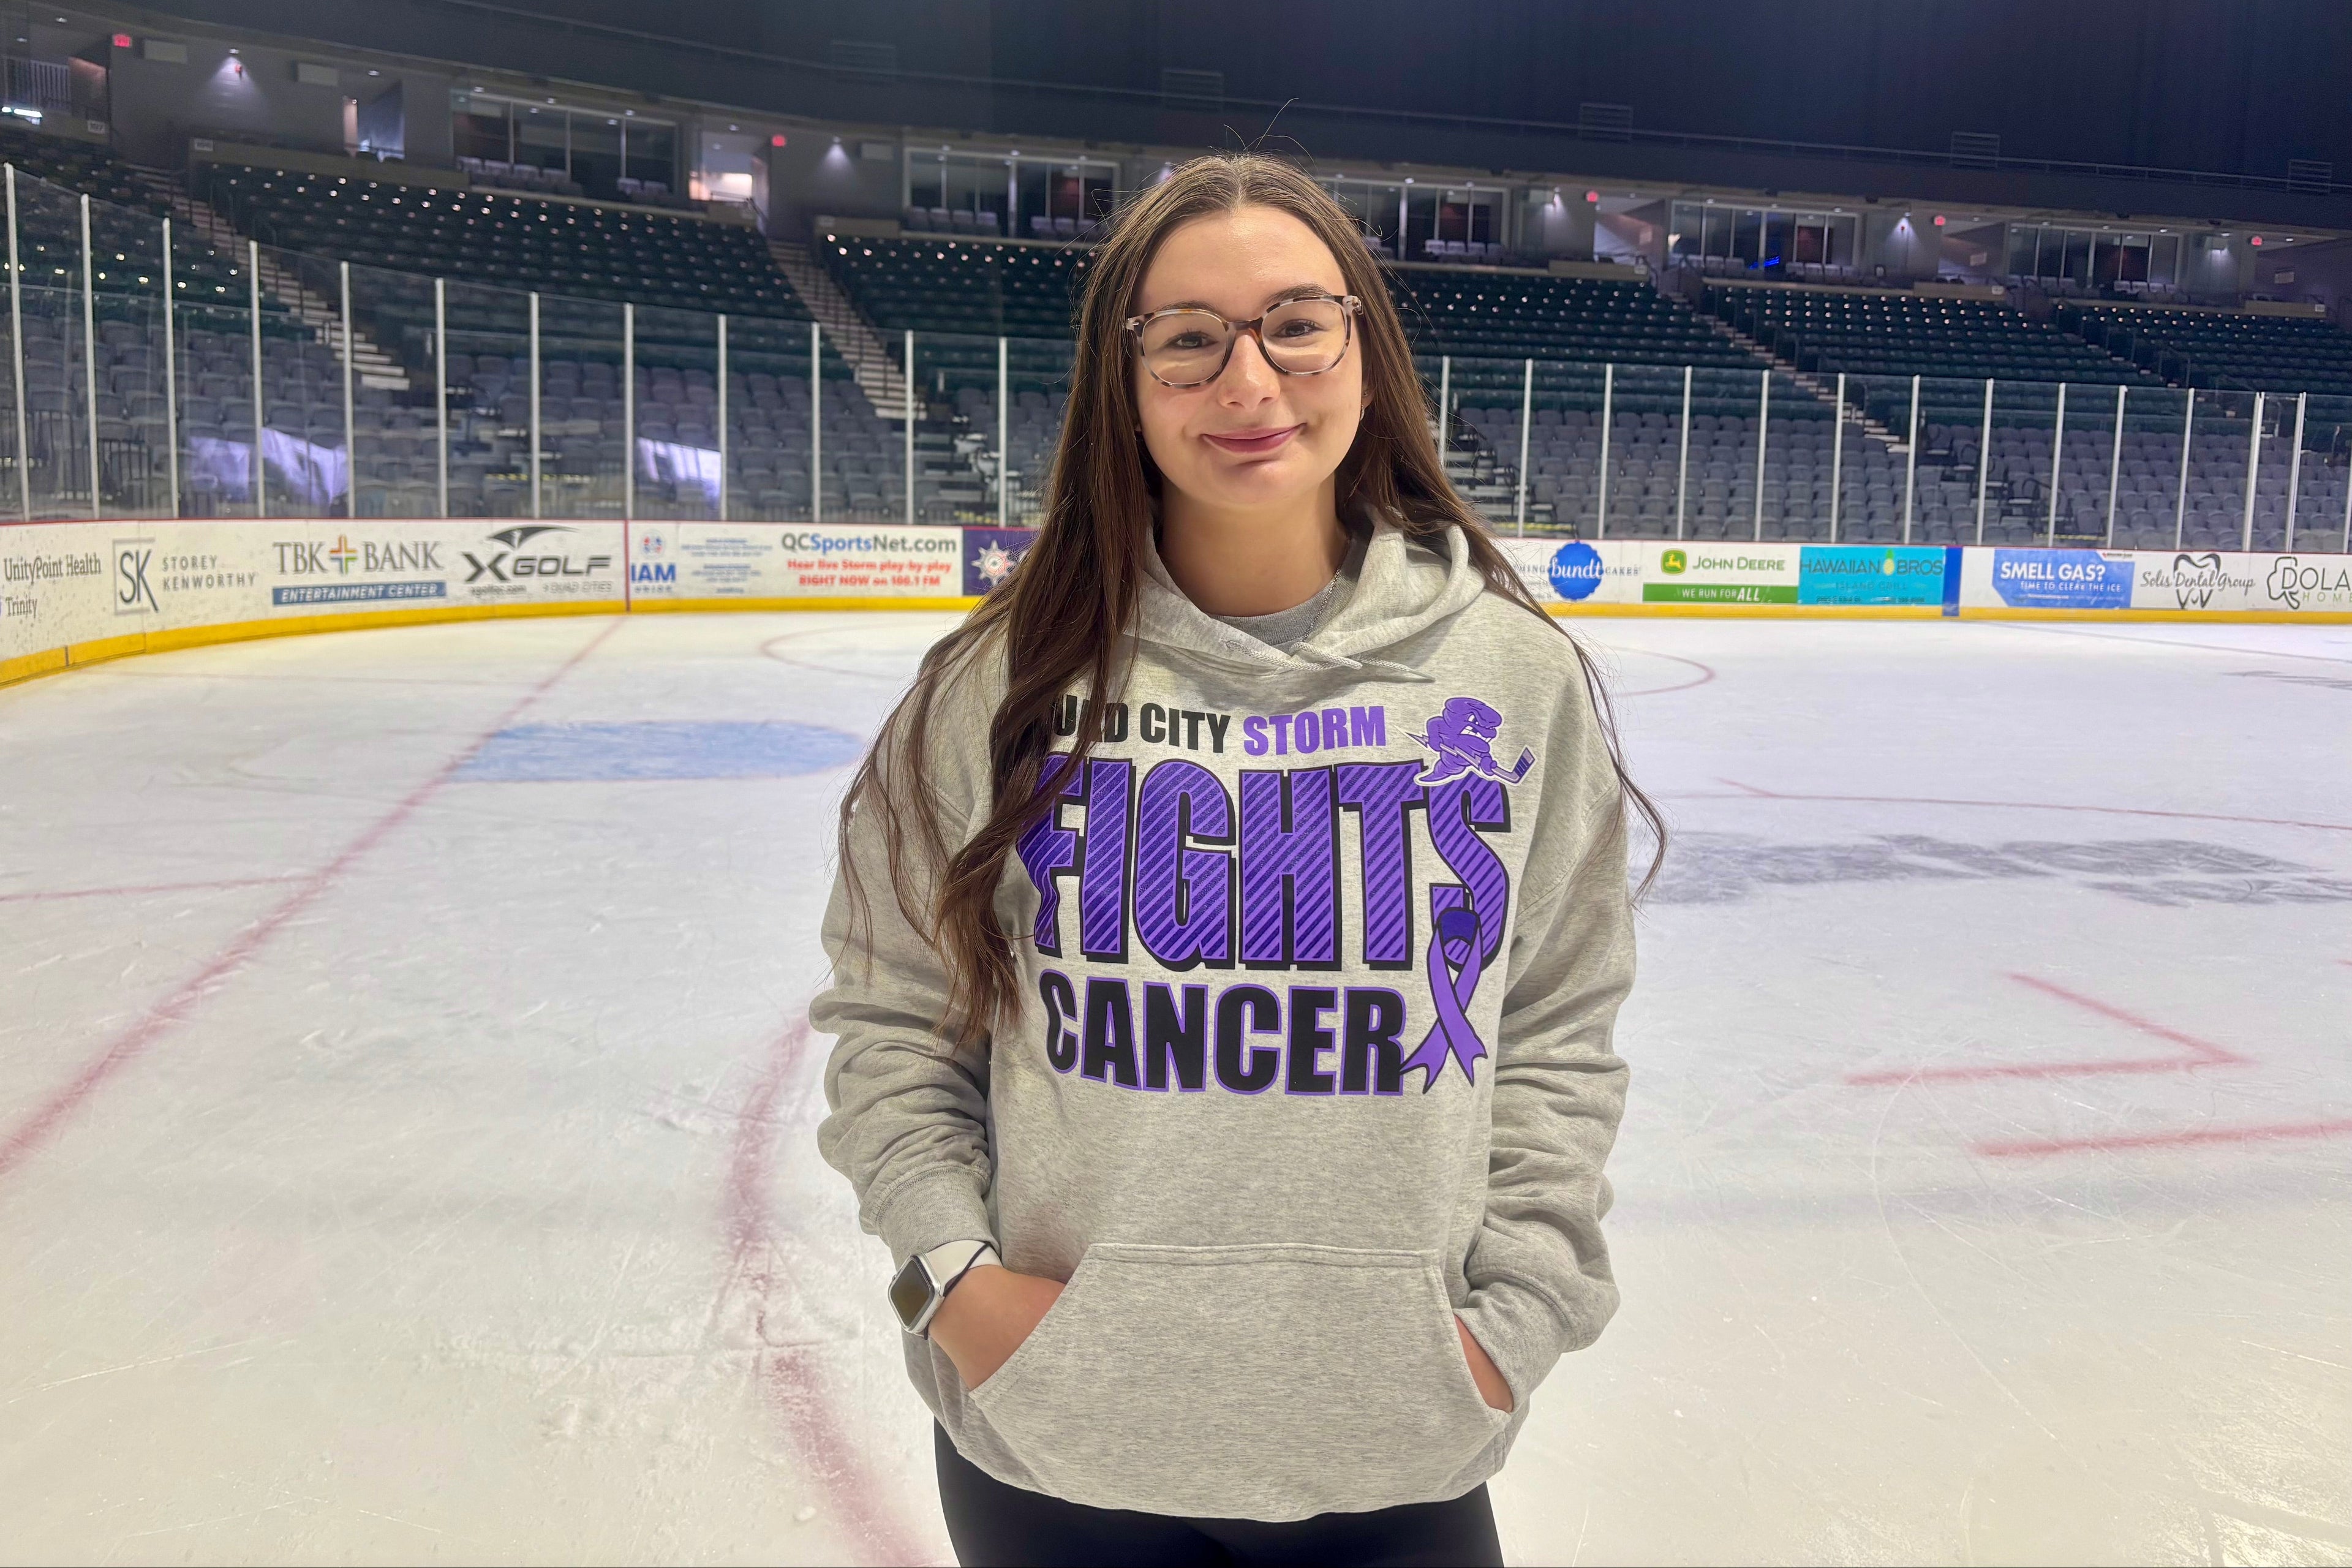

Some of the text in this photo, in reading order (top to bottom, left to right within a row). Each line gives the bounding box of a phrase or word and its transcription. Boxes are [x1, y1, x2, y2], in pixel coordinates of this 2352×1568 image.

[782, 533, 957, 555] QCSportsNet.com
[162, 555, 217, 571] STOREY
[273, 540, 445, 575] TBK BANK
[787, 559, 814, 570] Hear
[818, 559, 838, 570] live
[842, 559, 876, 570] Storm
[1551, 557, 1604, 579] bundt
[1692, 556, 1785, 571] JOHN DEERE
[1800, 558, 1943, 576] HAWAIIAN BROS
[4, 552, 102, 585] UnityPoint Health
[631, 562, 676, 582] IAM
[2000, 561, 2106, 581] SMELL GAS?
[120, 549, 159, 612] SK
[163, 572, 256, 592] KENWORTHY
[799, 575, 835, 586] RIGHT
[840, 575, 870, 586] NOW
[2140, 569, 2256, 596] Solis Dental Group
[281, 583, 438, 603] ENTERTAINMENT CENTER
[1682, 587, 1760, 601] WE RUN FOR ALL
[6, 594, 37, 619] Trinity
[1140, 703, 1231, 753] CITY
[1243, 706, 1386, 756] STORM
[1016, 751, 1512, 972] FIGHTS
[1040, 969, 1406, 1096] CANCER
